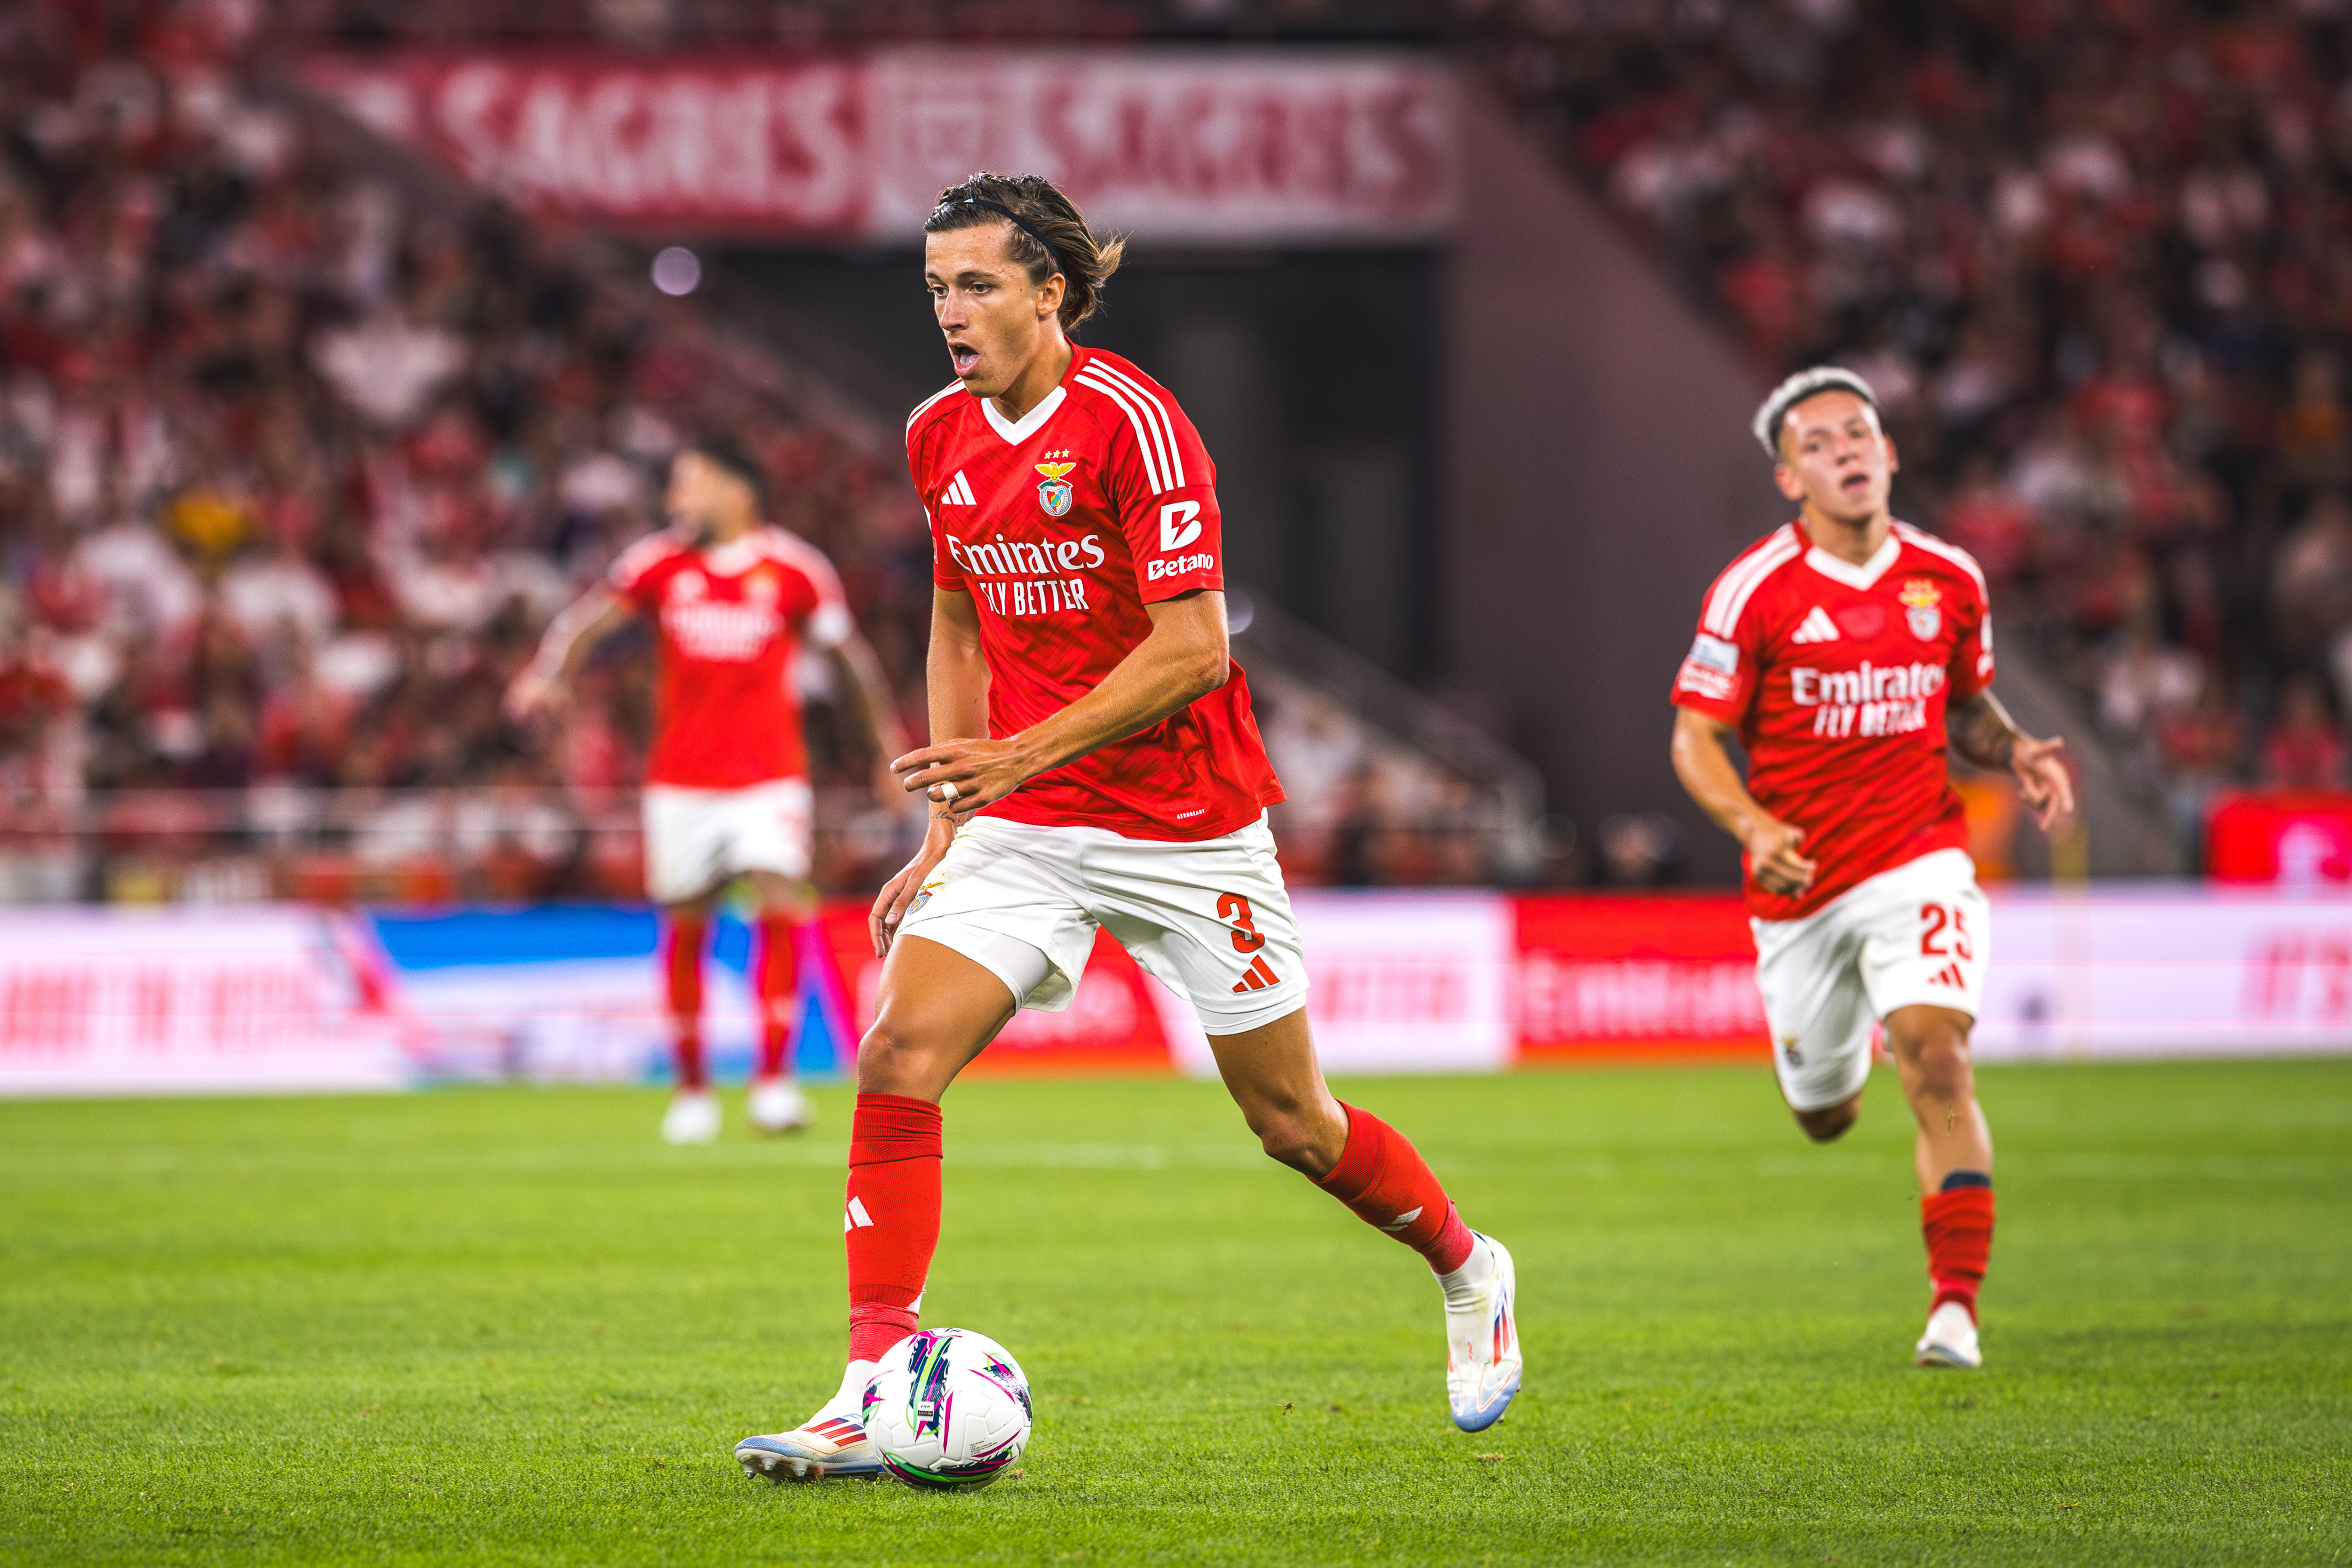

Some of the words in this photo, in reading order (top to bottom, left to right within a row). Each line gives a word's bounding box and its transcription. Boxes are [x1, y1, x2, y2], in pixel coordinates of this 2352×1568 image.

[946, 533, 1104, 575] Emirates
[1148, 553, 1214, 581] Betano
[979, 582, 1006, 615] FLY
[1013, 578, 1089, 615] BETTER
[1790, 660, 1946, 706] Emirate
[1177, 809, 1205, 819] AEROREADY
[1216, 891, 1265, 953] 3
[1921, 902, 1972, 962] 25
